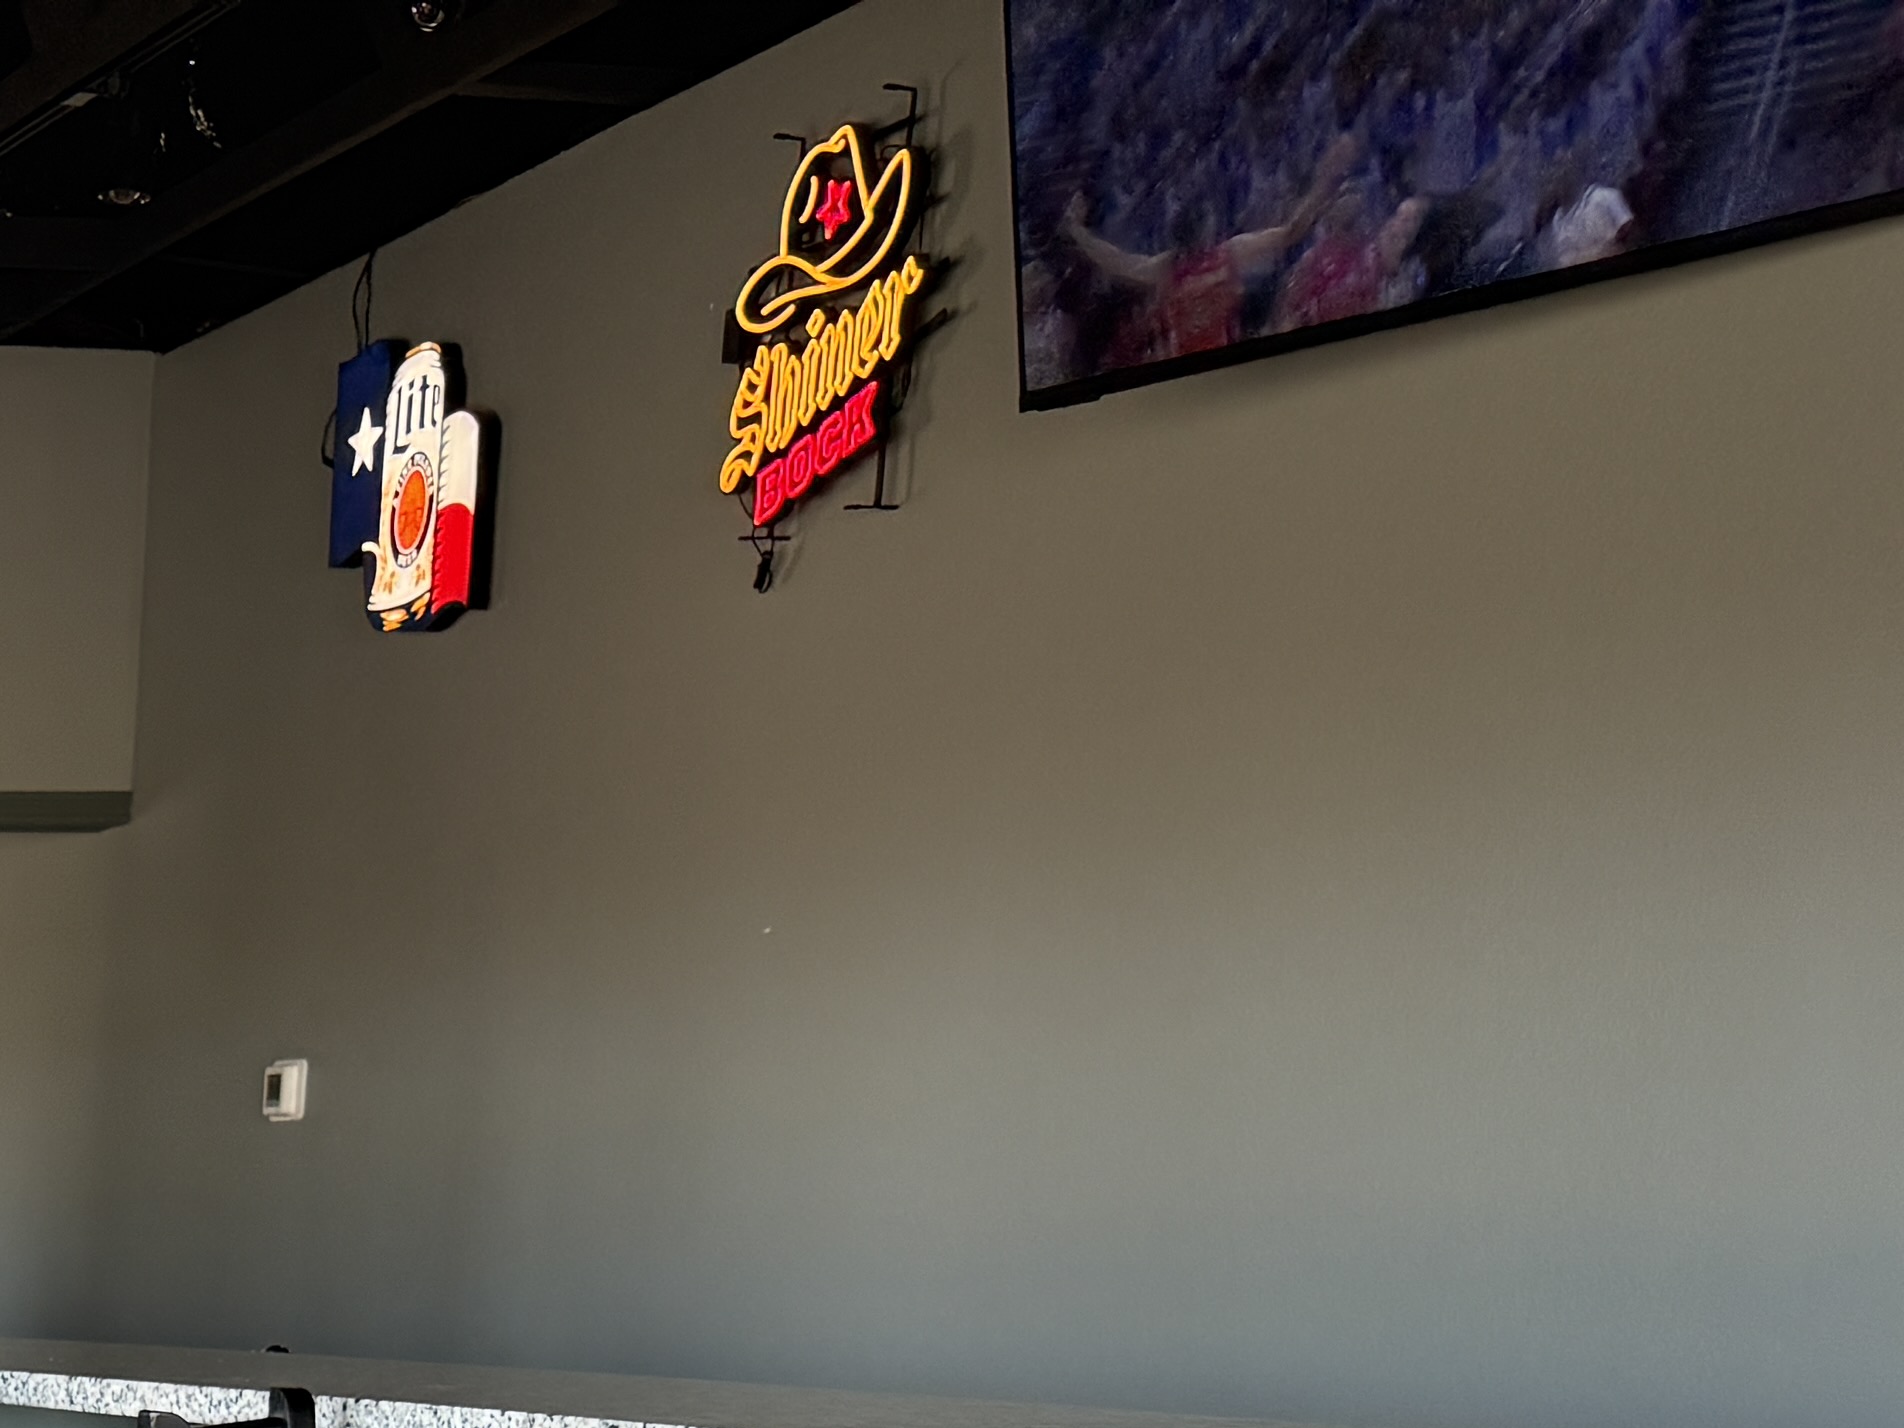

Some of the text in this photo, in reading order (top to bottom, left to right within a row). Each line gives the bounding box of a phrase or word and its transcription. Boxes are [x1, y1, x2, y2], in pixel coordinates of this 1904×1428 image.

[393, 374, 441, 455] Lite
[719, 255, 924, 493] Shiner
[754, 380, 879, 527] BOCK
